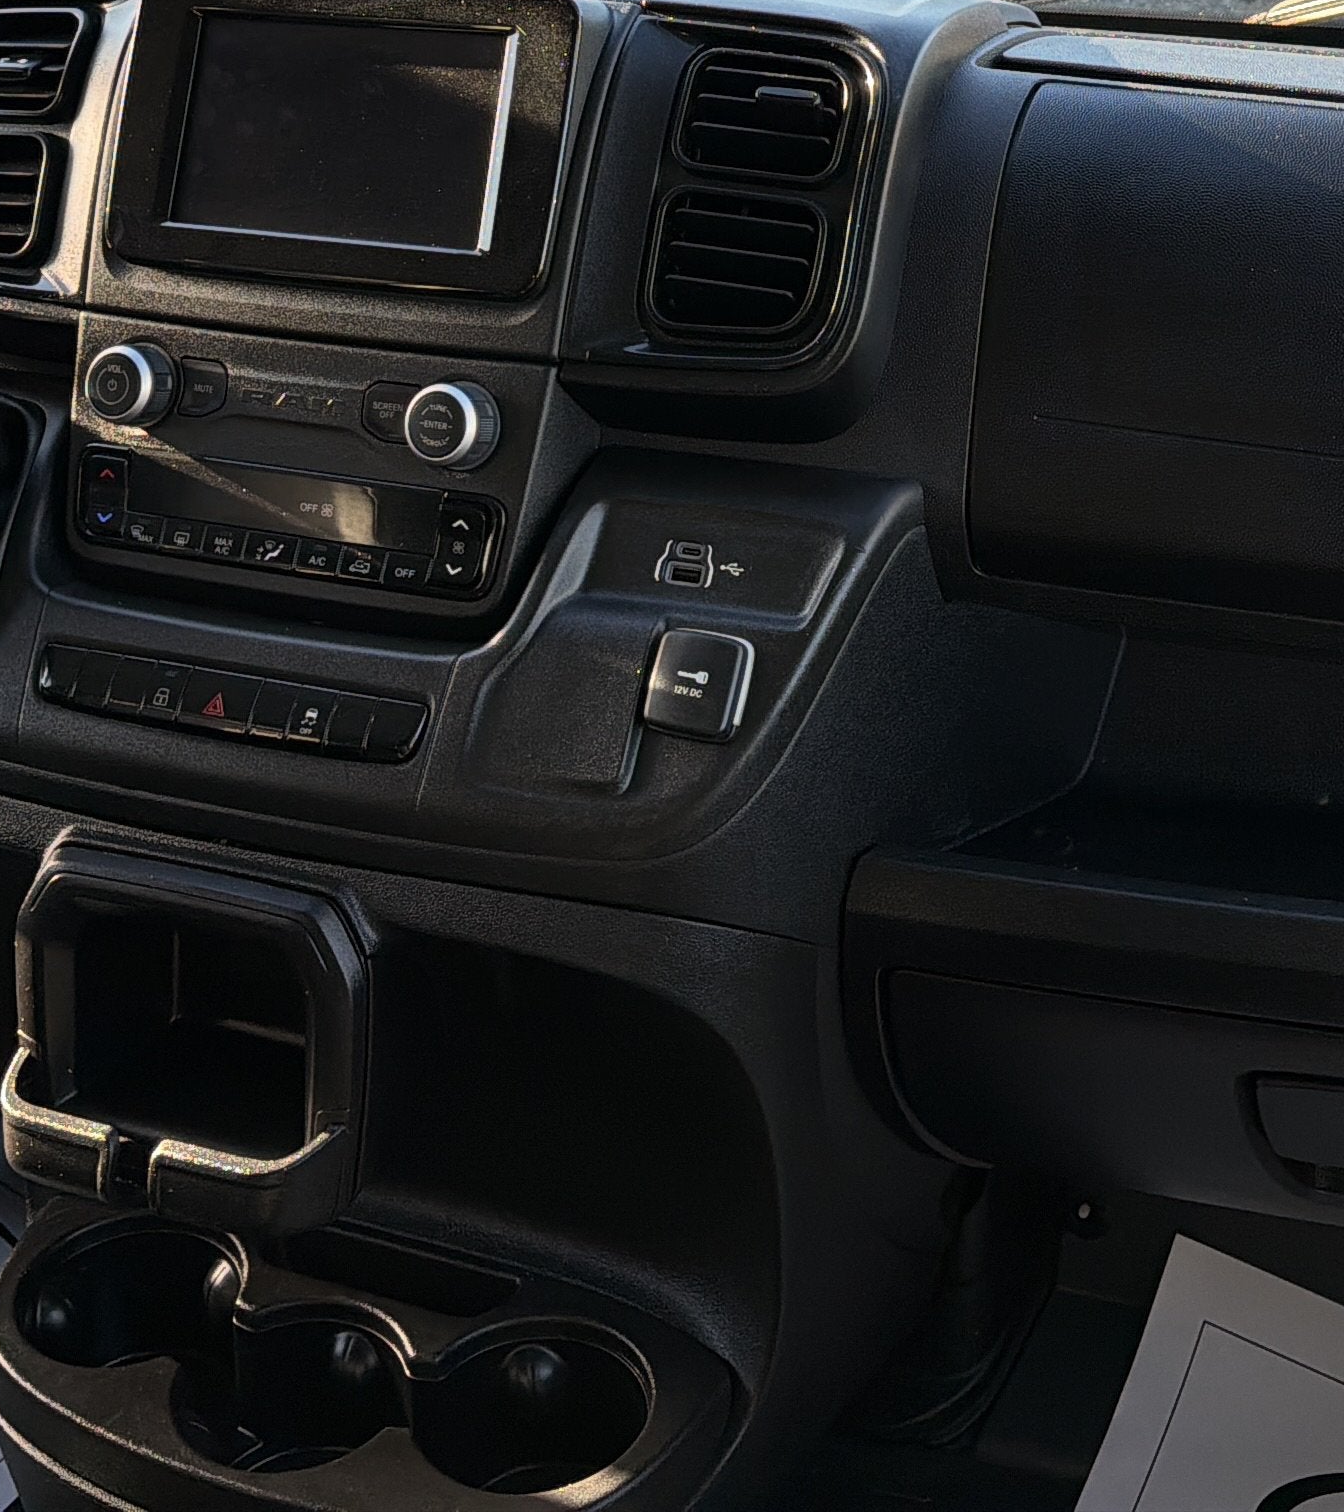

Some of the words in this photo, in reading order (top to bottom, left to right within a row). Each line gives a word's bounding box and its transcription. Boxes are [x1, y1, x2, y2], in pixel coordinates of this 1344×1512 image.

[107, 364, 123, 374] VOL
[193, 383, 215, 394] MUTE
[372, 400, 404, 412] SCREEN
[429, 403, 448, 413] TUNE
[379, 410, 395, 419] OFF
[423, 419, 448, 430] ENTER
[299, 502, 318, 513] OFF
[138, 534, 154, 544] MAX
[214, 536, 234, 547] MAX
[214, 546, 230, 556] A/C
[308, 555, 327, 567] A/C
[394, 567, 416, 578] OFF
[689, 687, 703, 699] DC
